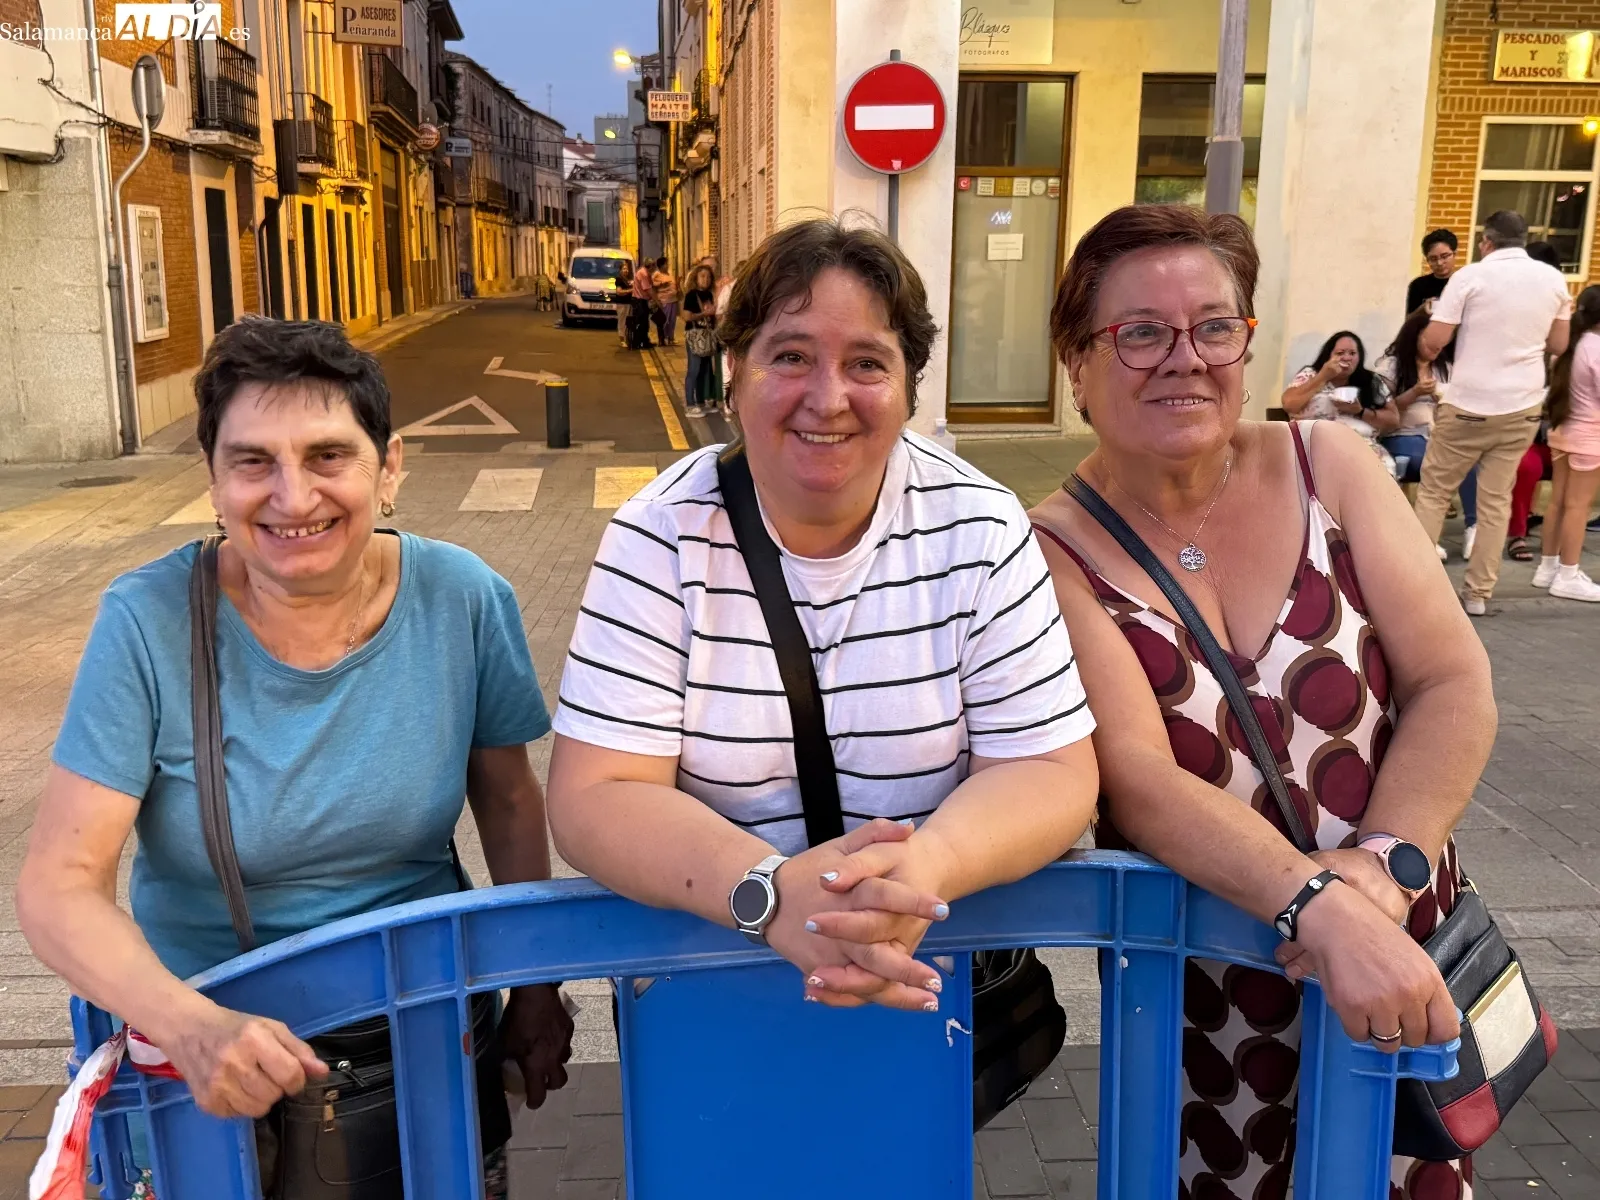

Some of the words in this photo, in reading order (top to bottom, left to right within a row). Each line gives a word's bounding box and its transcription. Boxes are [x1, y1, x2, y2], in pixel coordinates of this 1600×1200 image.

[361, 6, 397, 21] ASESORES
[341, 6, 397, 37] Peñaranda
[1503, 33, 1567, 45] PESCADOS
[1529, 50, 1539, 61] Y
[1500, 66, 1563, 78] MARISCOS
